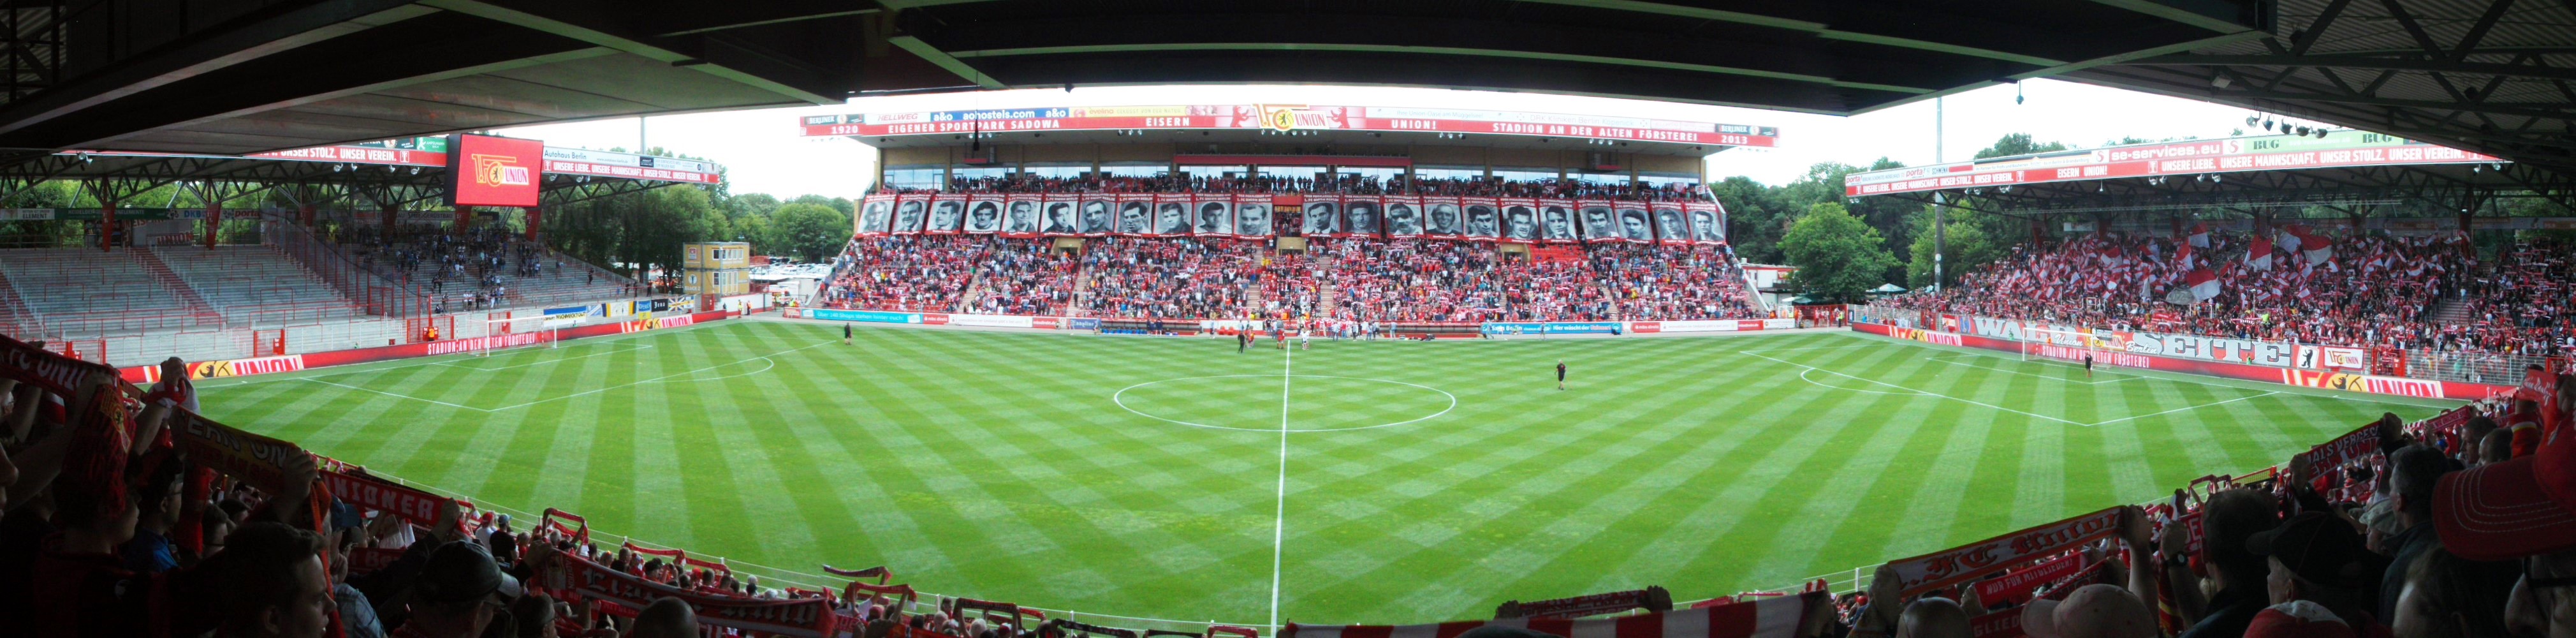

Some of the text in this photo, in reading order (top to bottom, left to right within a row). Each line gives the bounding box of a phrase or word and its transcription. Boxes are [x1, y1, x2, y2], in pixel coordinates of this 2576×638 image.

[878, 113, 918, 121] HELLWEG
[933, 109, 1065, 121] a&o aohostels.com a&o
[1146, 117, 1190, 126] EISERN
[1294, 113, 1326, 126] UNION
[832, 125, 858, 134] 1920
[888, 119, 1060, 134] EIGENER SPORTPARK SADOWA
[1391, 120, 1436, 129] UNION!
[1493, 122, 1697, 141] STADION AN DER ALTEN FÖRSTEREI
[1722, 135, 1748, 144] 2013
[2253, 139, 2279, 150] BUG
[2363, 134, 2392, 143] BUG
[310, 146, 337, 158] STOLZ.
[340, 149, 366, 160] UNSER
[368, 151, 397, 161] VEREIN.
[545, 150, 570, 159] Autohaus
[2111, 144, 2220, 161] se-services.eu
[2162, 147, 2464, 172] UNSERE LIEBE. UNSERE MANNSCHAFT. UNSER STOLZ. UNSER VEREIN.
[505, 168, 527, 182] UNION
[553, 161, 701, 181] UNSERE LIEBE. UNSERE MANNSCHAFT. UNSER STOLZ. UNSER VEREIN.
[2058, 165, 2107, 179] EISERN UNION!
[1863, 172, 2014, 193] UNSERE LIEBE. UNSERE MANNSCHAFT. UNSER STOLZ. UNSER VEREIN.
[662, 315, 693, 328] UNION
[1927, 332, 1961, 346] UNION
[2056, 334, 2084, 346] Union
[428, 341, 457, 355] STADION
[458, 339, 467, 352] AN
[470, 338, 481, 350] DER
[485, 337, 502, 348] ALTEN
[2126, 341, 2158, 354] Berlin
[2043, 346, 2066, 359] STADION
[2068, 347, 2076, 359] AN
[2094, 351, 2112, 364] ALTEN
[234, 358, 299, 375] UNION
[2366, 378, 2438, 398] UNION
[1987, 583, 2005, 595] NUR
